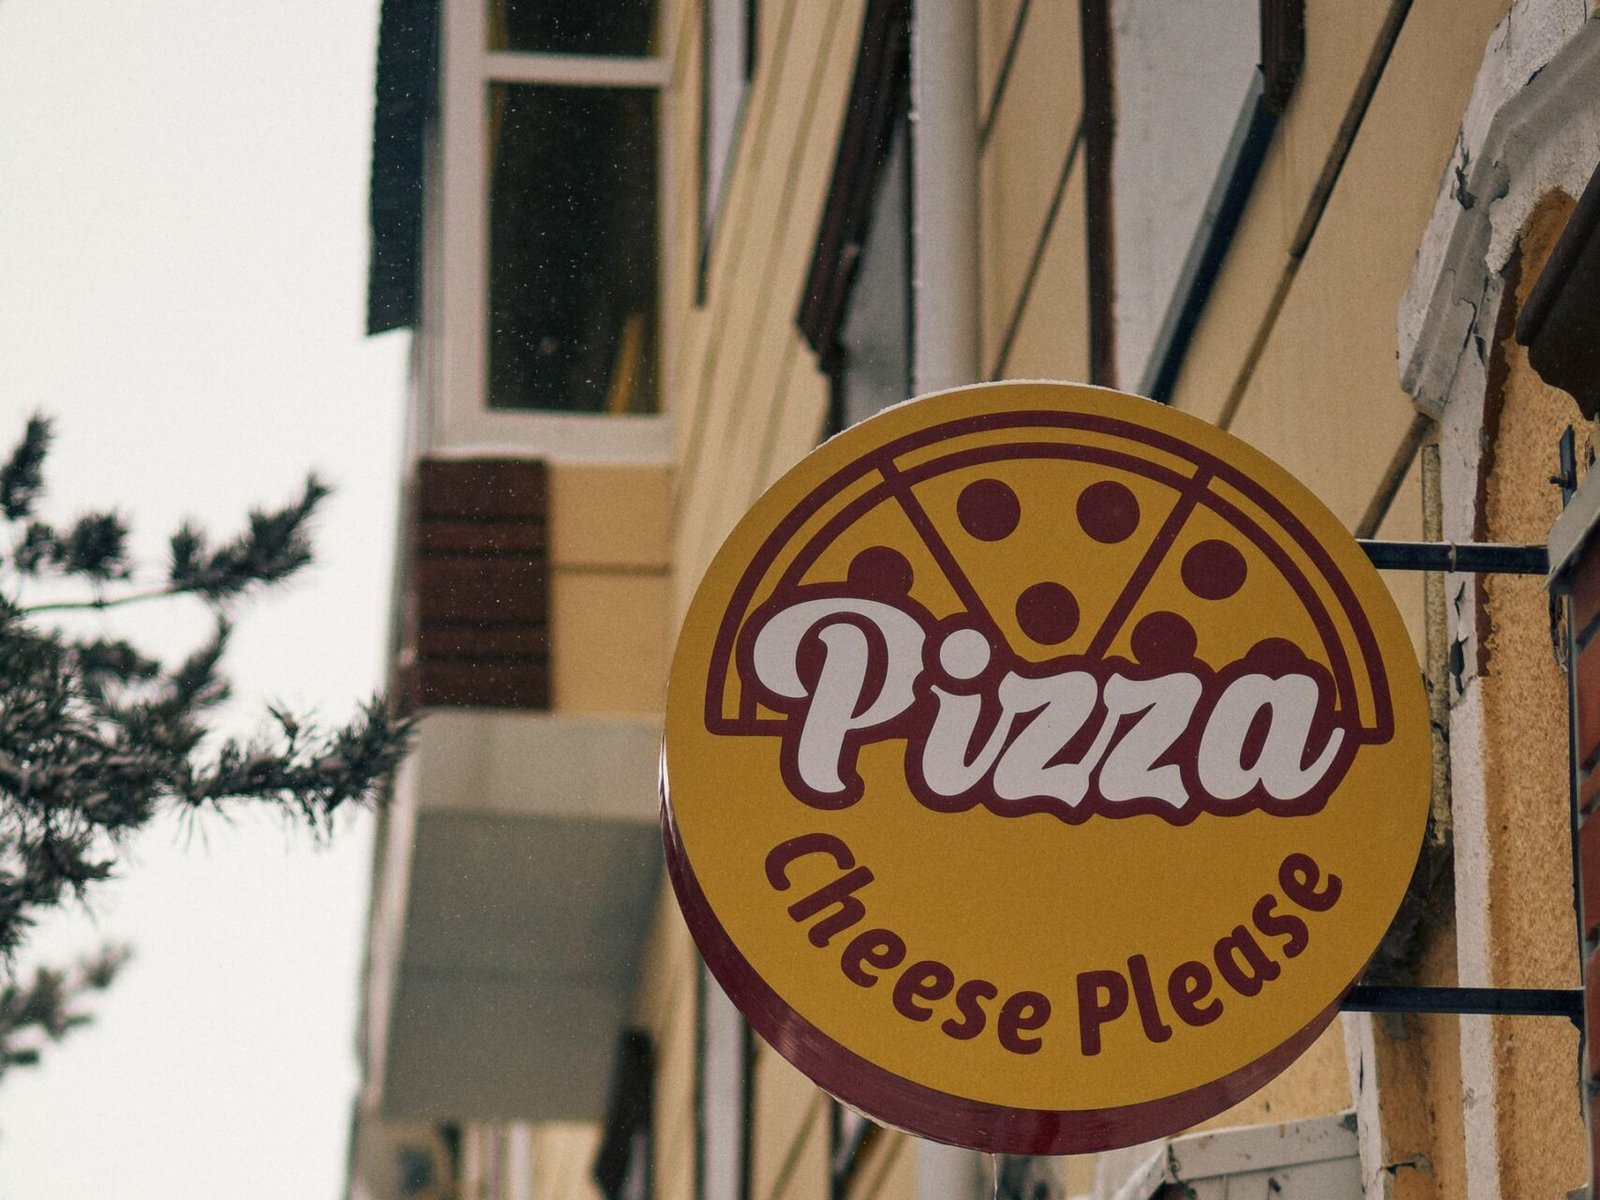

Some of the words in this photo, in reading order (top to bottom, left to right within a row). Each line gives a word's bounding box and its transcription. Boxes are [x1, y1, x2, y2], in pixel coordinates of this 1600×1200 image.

[753, 598, 1346, 808] Pizza
[765, 833, 1052, 1056] Cheese
[1076, 853, 1343, 1057] Please
